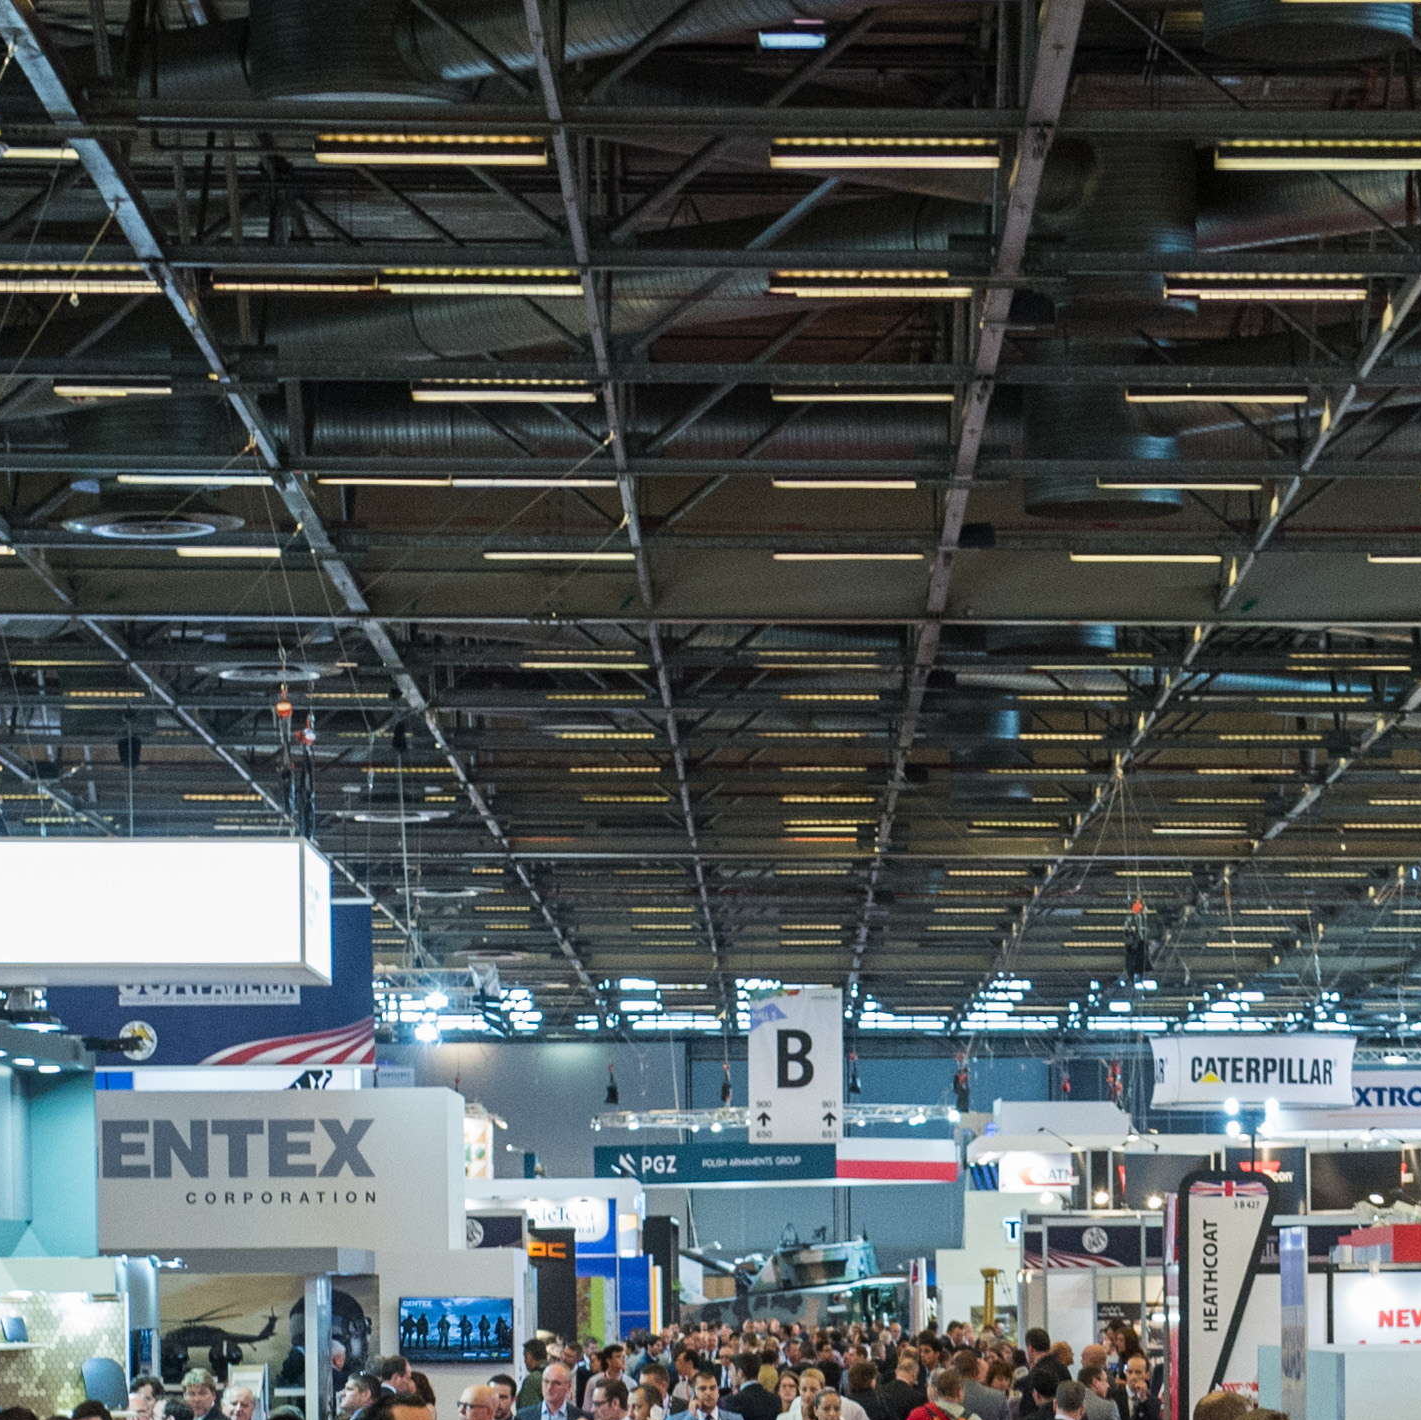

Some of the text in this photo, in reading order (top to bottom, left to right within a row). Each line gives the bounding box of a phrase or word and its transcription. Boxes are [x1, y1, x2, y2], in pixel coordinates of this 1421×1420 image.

[776, 1029, 814, 1089] B
[1190, 1056, 1334, 1086] CATERPILLAR
[98, 1118, 376, 1179] ENTEX
[702, 1159, 727, 1168] POLISH
[775, 1155, 801, 1166] GROUP
[641, 1156, 677, 1173] PGZ
[185, 1191, 377, 1204] CORPORATION
[1203, 1219, 1218, 1332] HEATHCOAT
